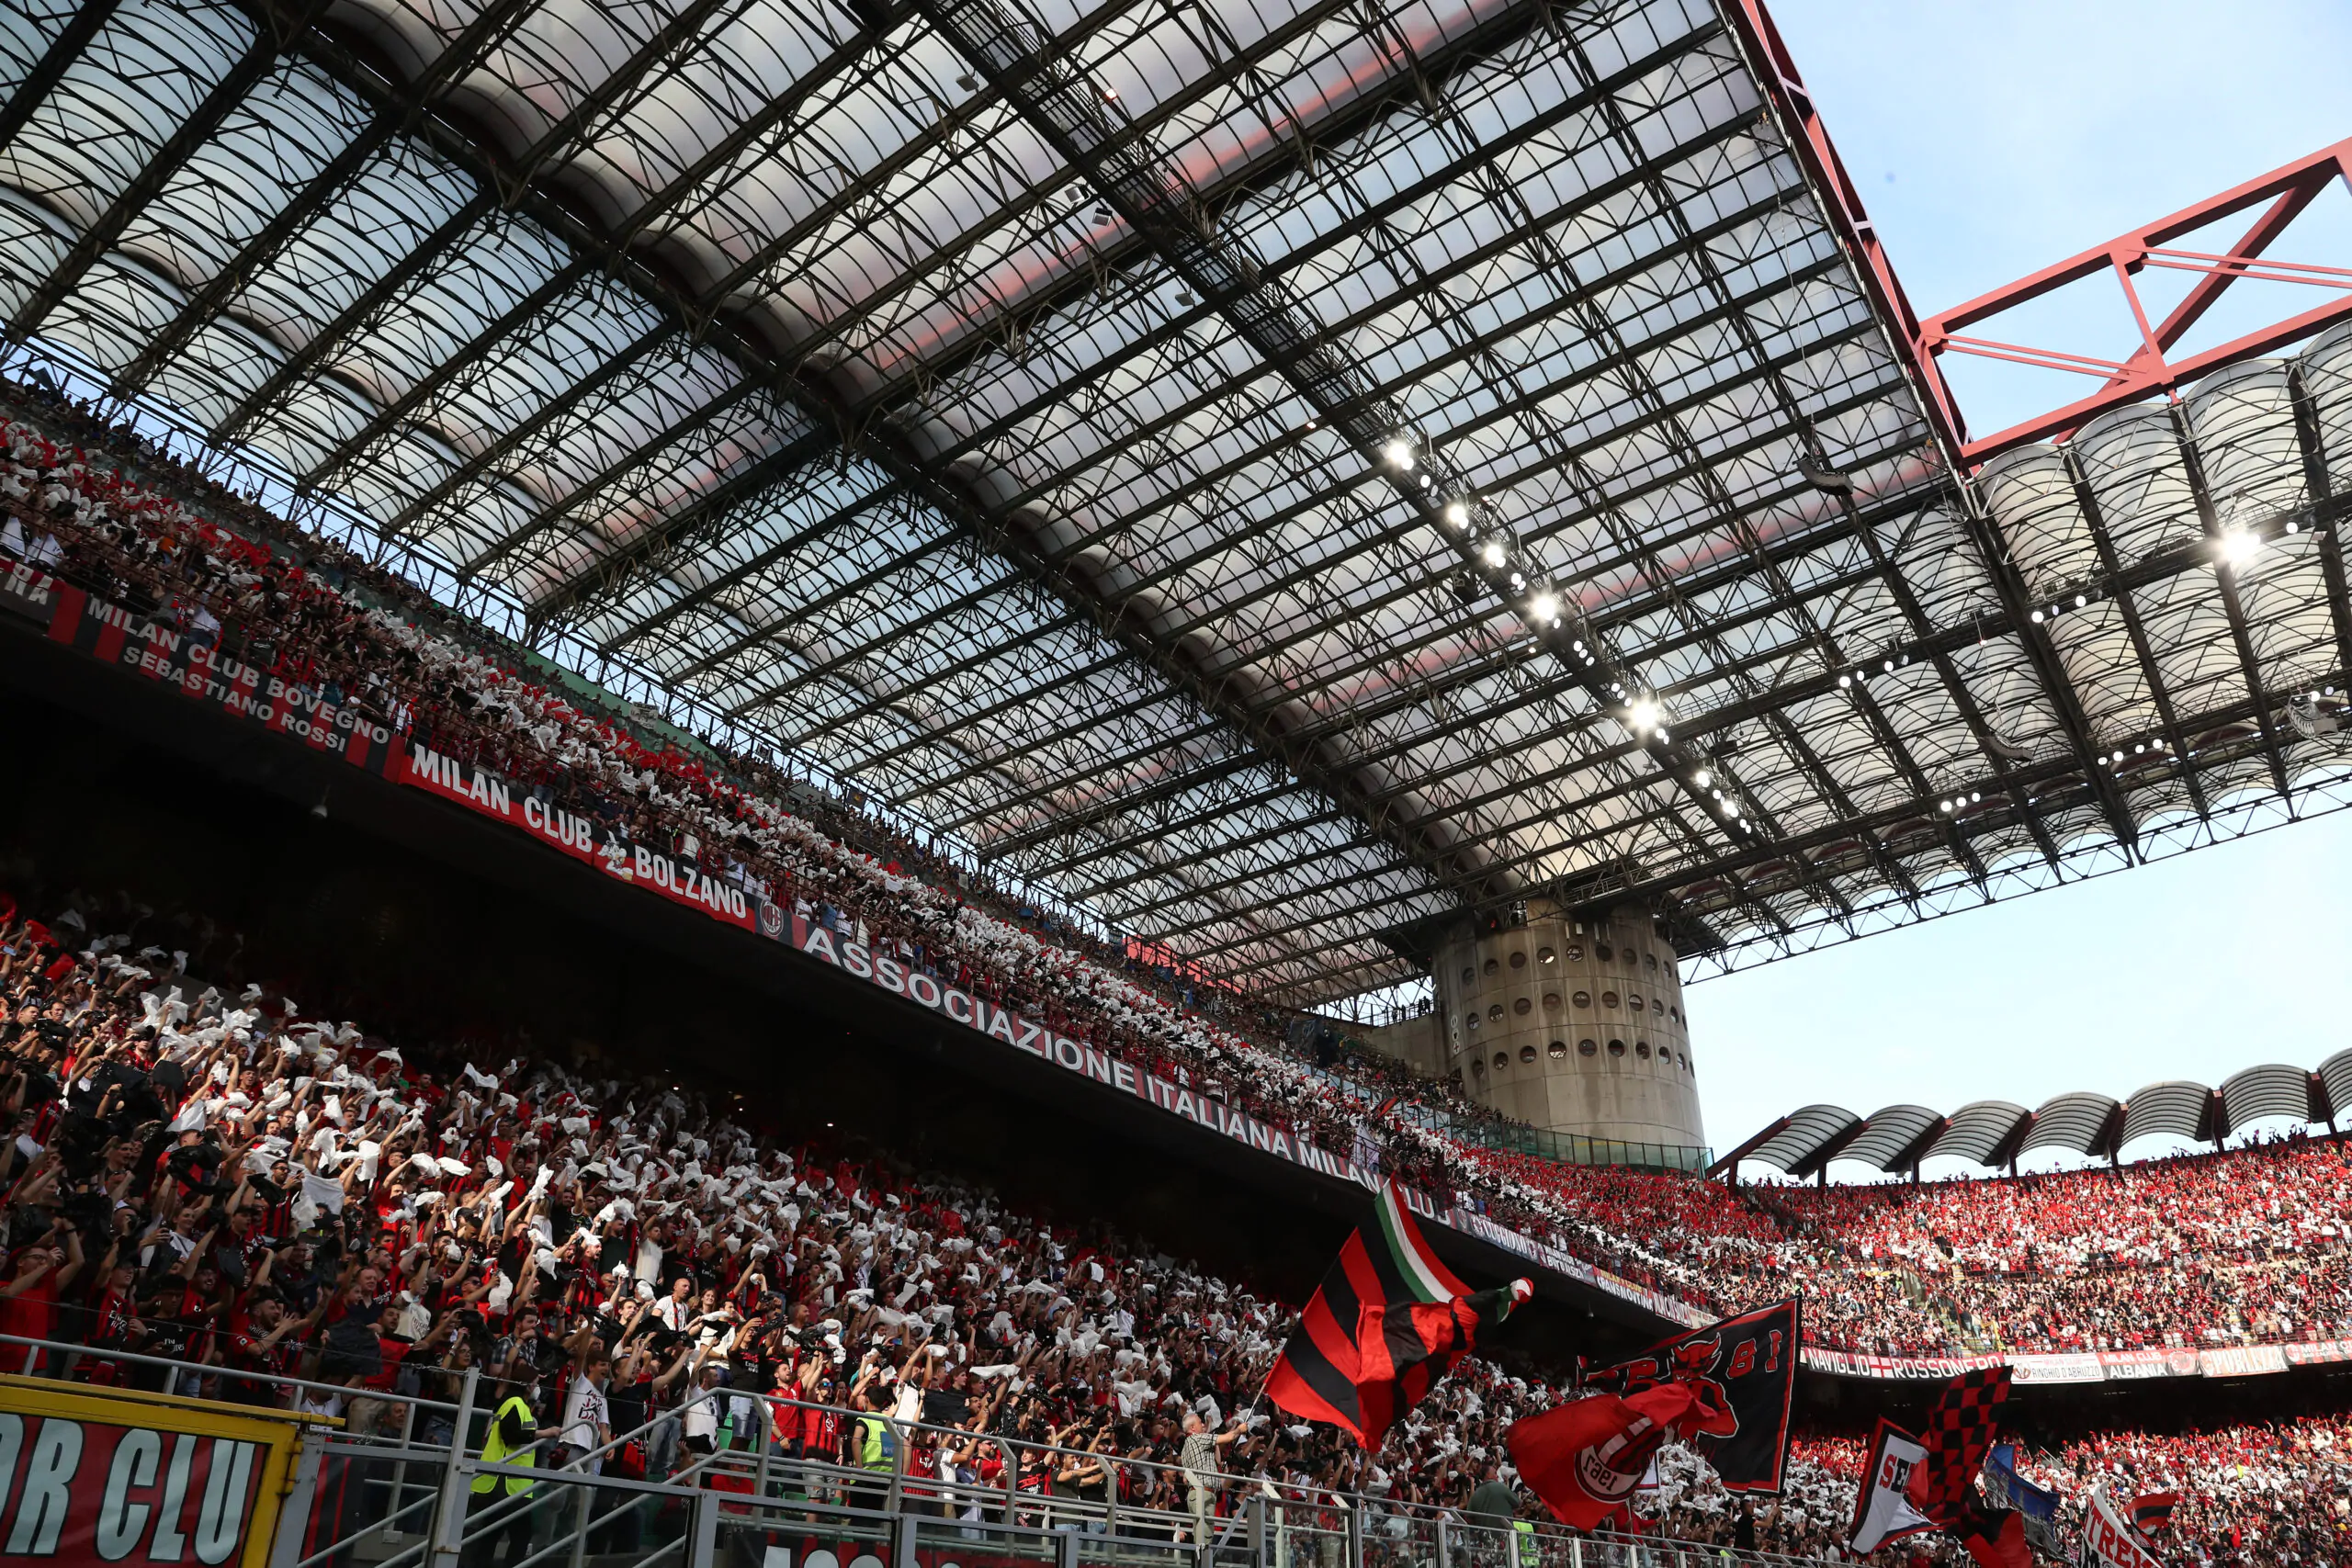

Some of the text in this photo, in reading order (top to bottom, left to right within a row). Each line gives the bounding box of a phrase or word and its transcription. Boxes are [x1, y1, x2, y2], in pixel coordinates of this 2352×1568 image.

[88, 596, 390, 745] MILAN CLUB BOVEGNO
[123, 646, 346, 753] SEBASTIANO ROSSI
[411, 742, 747, 919] MILAN CLUB BOLZANO
[803, 927, 1137, 1095] ASSOCIAZIONE
[1147, 1074, 1294, 1162] ITALIANA
[1296, 1139, 1381, 1194] MILAN
[1807, 1348, 1871, 1376] NAVIGLIO
[2103, 1351, 2163, 1364] MILAN CLUB
[2109, 1363, 2168, 1379] ALBANIA
[96, 1427, 256, 1565] CLU
